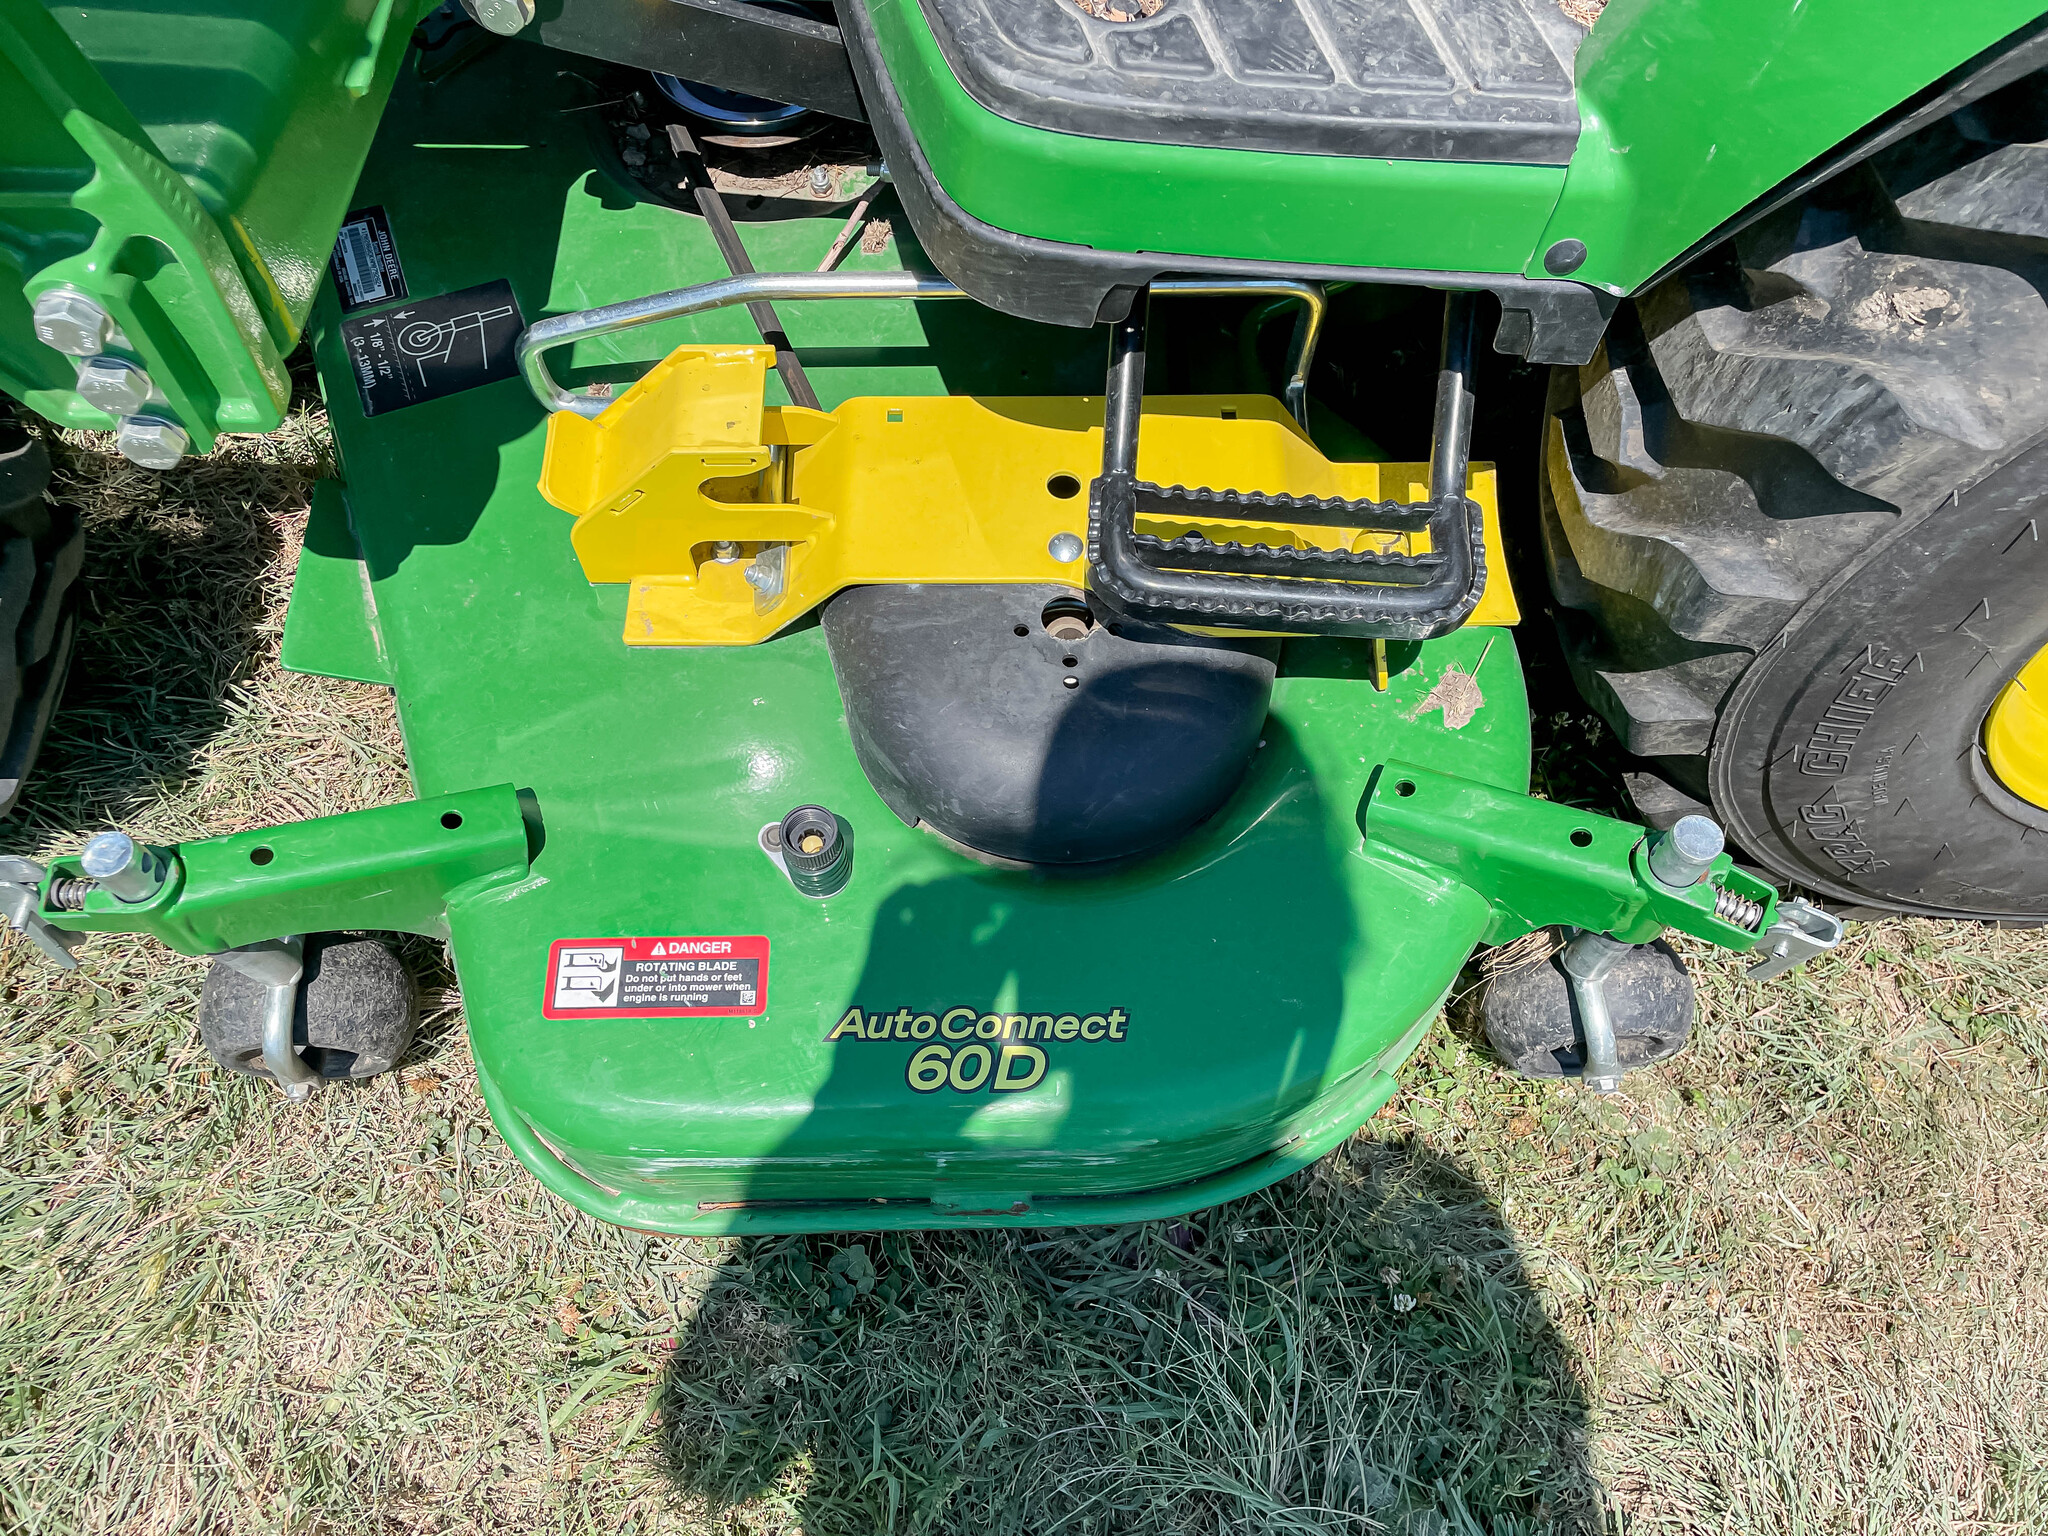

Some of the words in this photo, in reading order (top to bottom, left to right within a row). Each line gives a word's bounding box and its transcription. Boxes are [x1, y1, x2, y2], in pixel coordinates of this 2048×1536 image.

[378, 230, 391, 252] JOHN
[384, 253, 399, 280] DEERE
[350, 336, 365, 347] (3
[359, 354, 377, 389] 13MM)
[1799, 646, 1908, 777] CHIEF
[1799, 803, 1890, 874] TRAC
[668, 941, 732, 955] DANGER
[625, 974, 639, 983] Do
[641, 975, 658, 983] not
[660, 974, 676, 984] put
[678, 973, 709, 982] hands
[723, 973, 743, 981] feet
[636, 962, 695, 972] ROTATING
[697, 961, 738, 971] BLADE
[623, 994, 657, 1004] engine
[659, 993, 668, 1001] is
[670, 993, 709, 1003] running
[624, 984, 653, 993] under
[668, 983, 687, 992] into
[689, 984, 723, 992] mower
[724, 983, 751, 991] when
[827, 1007, 1128, 1041] AutoConnect
[906, 1043, 1048, 1093] 60D
